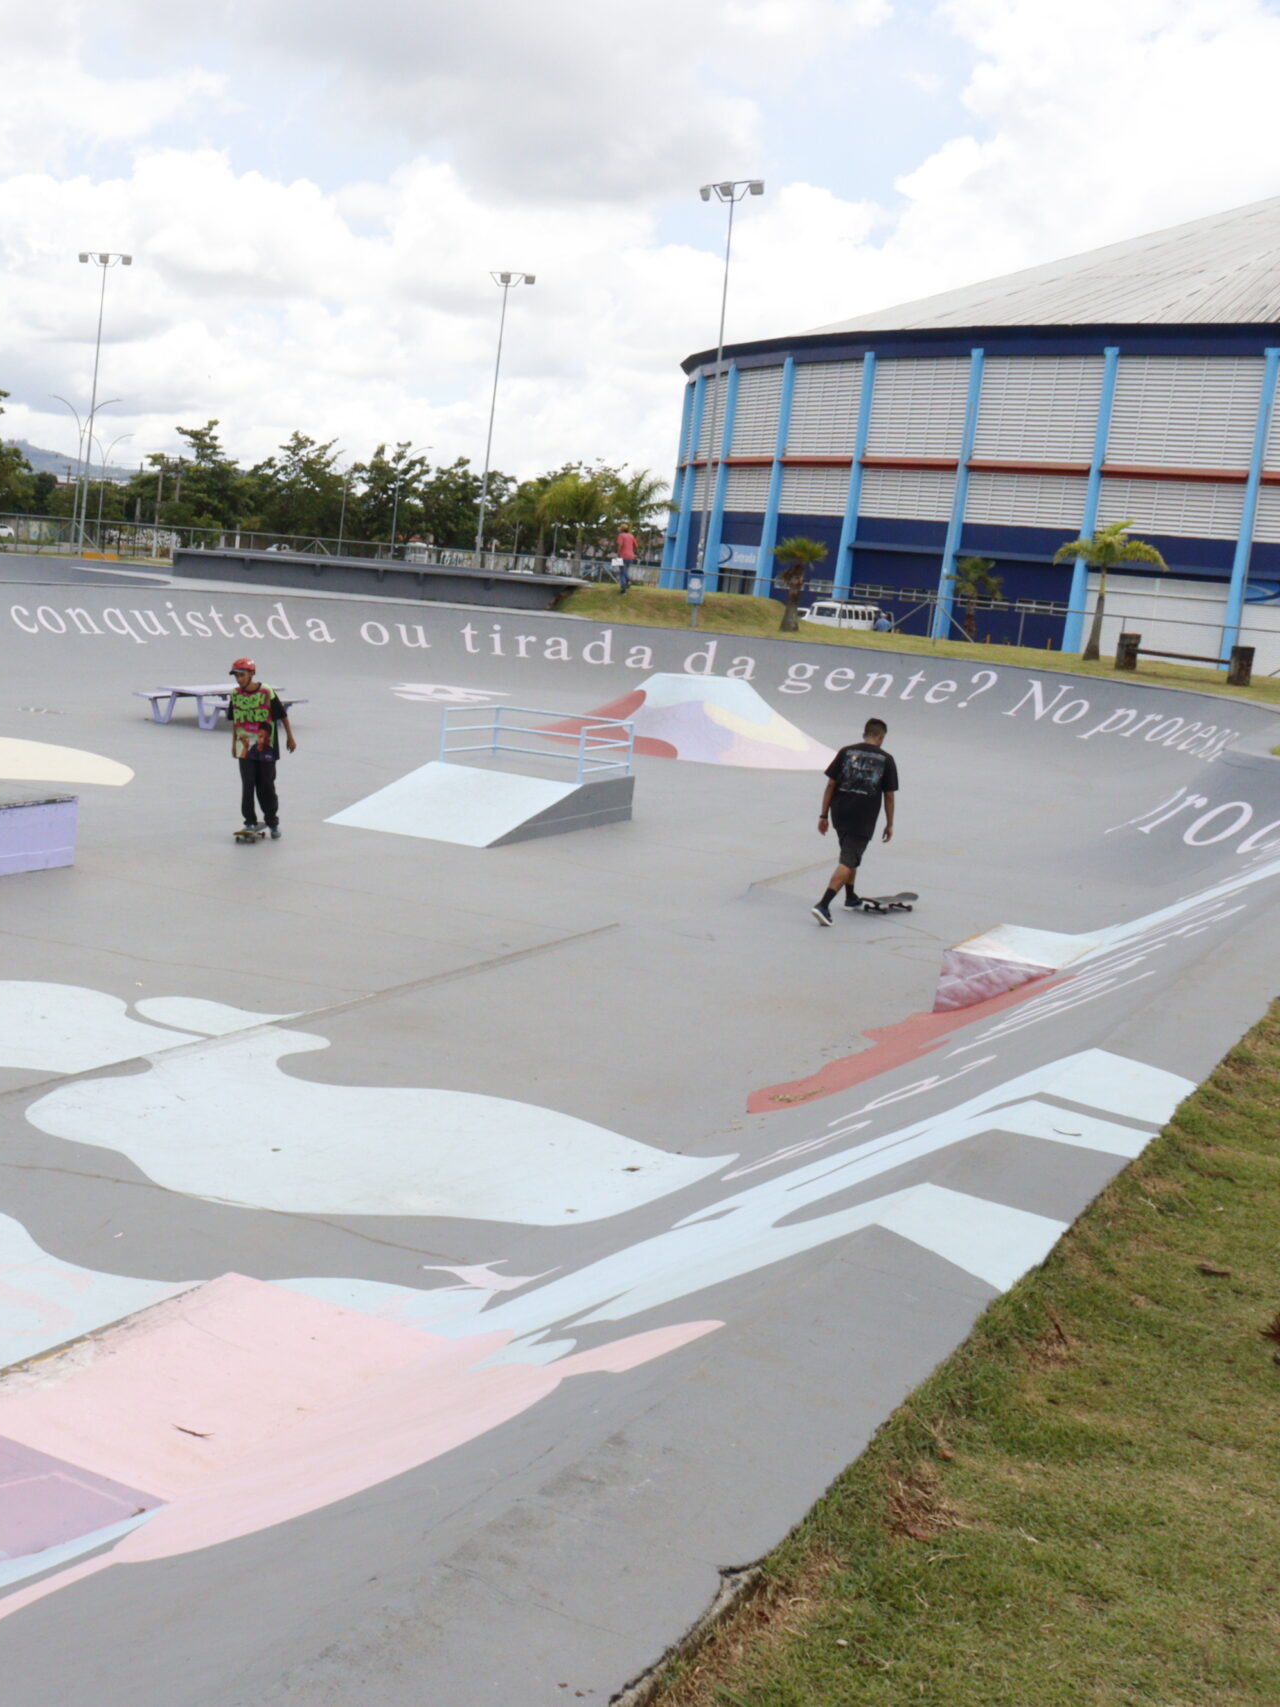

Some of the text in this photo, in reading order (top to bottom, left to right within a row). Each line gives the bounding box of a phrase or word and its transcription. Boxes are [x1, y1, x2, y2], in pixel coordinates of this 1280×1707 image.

[9, 602, 337, 645] conquistada
[359, 620, 432, 650] ou
[460, 620, 655, 671] tirada
[682, 640, 756, 681] da
[778, 669, 998, 709] gente?
[1001, 679, 1091, 724] No
[1075, 707, 1240, 762] process
